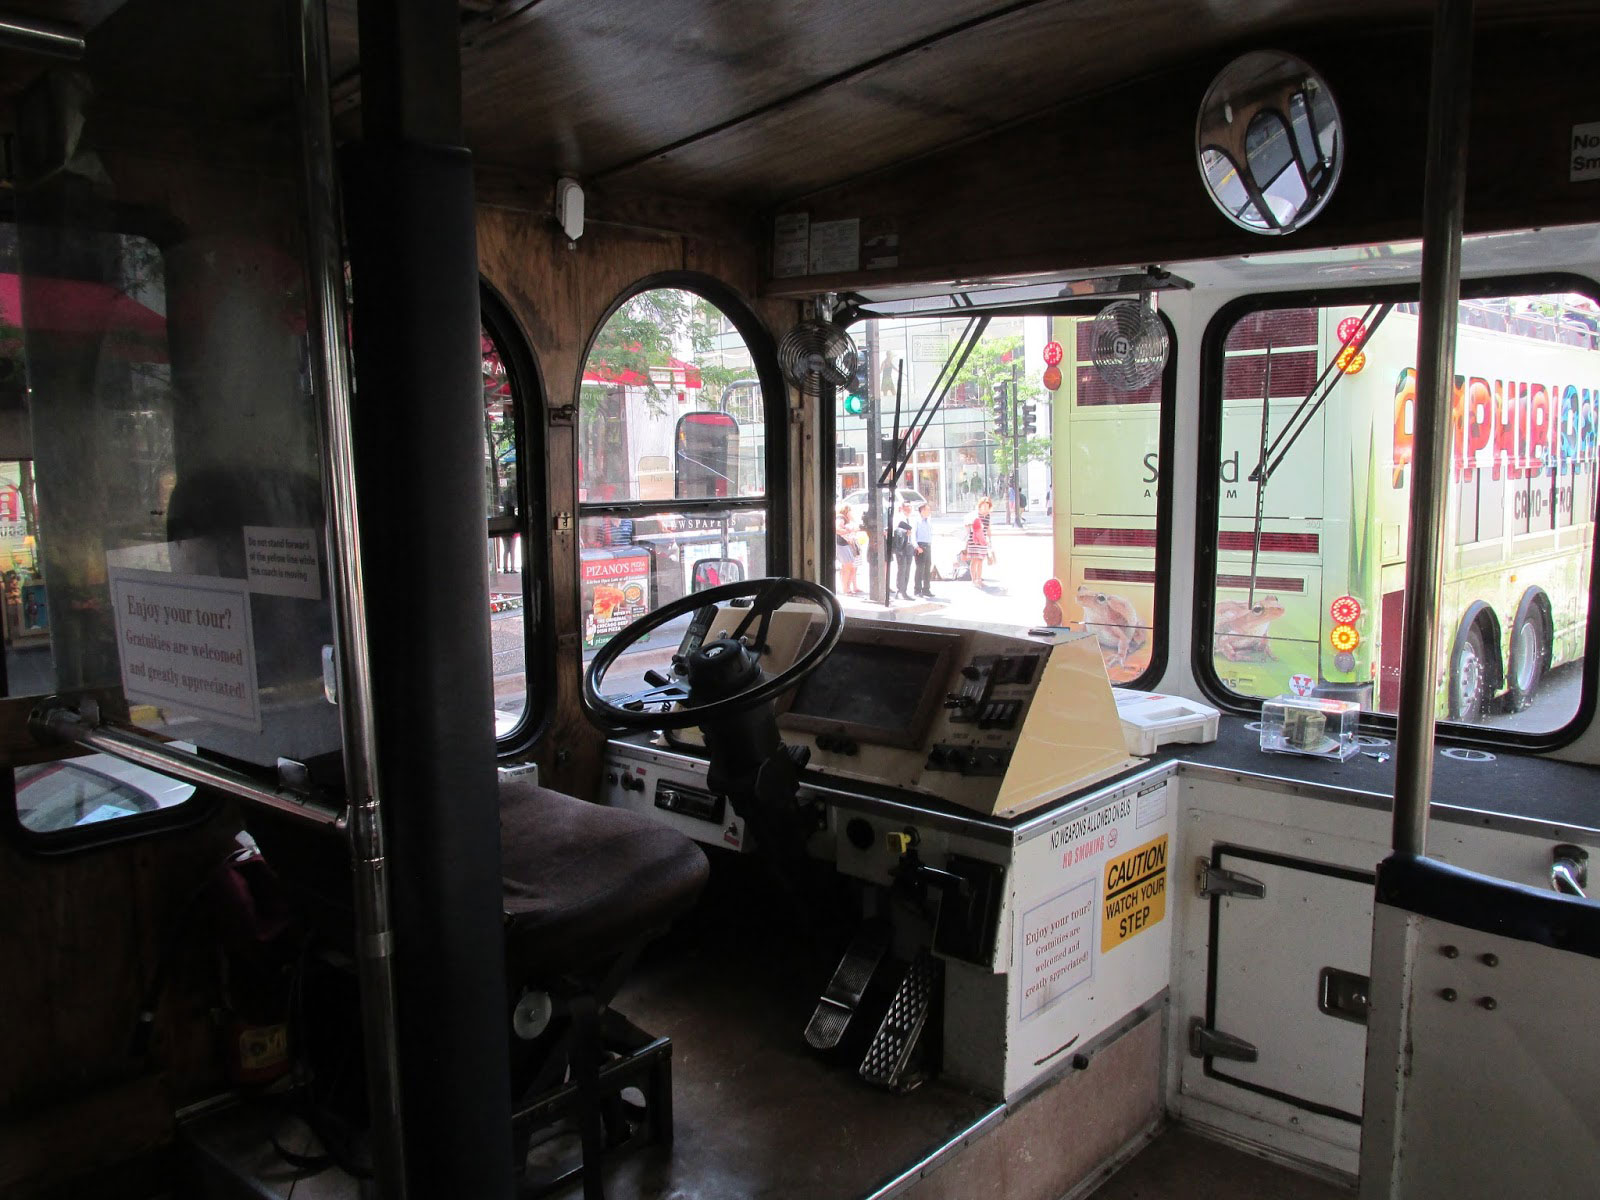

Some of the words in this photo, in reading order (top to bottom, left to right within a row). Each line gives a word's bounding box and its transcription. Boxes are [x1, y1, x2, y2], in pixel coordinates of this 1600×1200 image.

[662, 516, 737, 529] NEWSPAPES
[586, 562, 630, 577] PIZANO'S
[127, 595, 160, 624] Enjoy
[164, 606, 193, 625] your
[196, 608, 232, 629] tour?
[126, 629, 171, 651] Gratuities
[173, 641, 189, 656] are
[192, 643, 243, 666] welcomed
[130, 661, 146, 677] and
[148, 666, 179, 688] greatly
[181, 675, 246, 699] appreciated!
[1050, 831, 1060, 850] NO
[1060, 820, 1087, 845] WEAPONS
[1086, 808, 1112, 836] ALLOWED
[1111, 804, 1121, 823] ON
[1120, 799, 1132, 819] BUS
[1062, 850, 1073, 869] NO
[1074, 835, 1105, 863] SMOKING
[1107, 841, 1167, 890] CAUTION
[1106, 891, 1139, 920] WATCH
[1141, 877, 1165, 900] YOUR
[1025, 926, 1048, 946] Enjoy
[1049, 914, 1070, 934] your
[1070, 900, 1092, 921] tour?
[1119, 906, 1150, 938] STEP
[1035, 934, 1069, 957] Gratuities
[1069, 927, 1081, 938] are
[1035, 947, 1067, 973] welcomed
[1067, 940, 1081, 955] and
[1025, 977, 1047, 999] greatly
[1049, 950, 1089, 982] appreciated!
